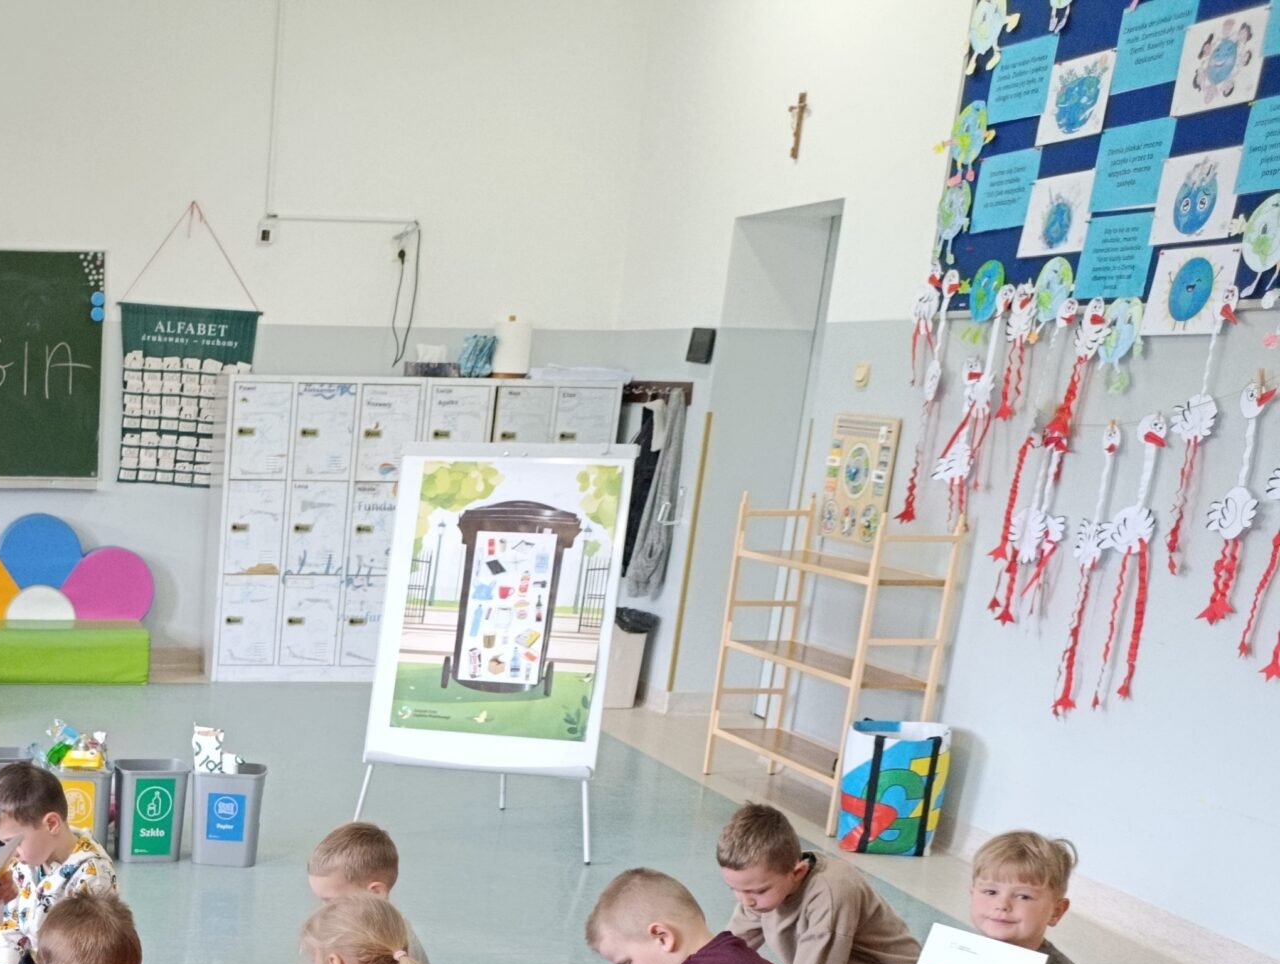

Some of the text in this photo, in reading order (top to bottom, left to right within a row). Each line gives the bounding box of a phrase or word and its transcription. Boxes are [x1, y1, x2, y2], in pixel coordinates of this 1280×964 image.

[154, 320, 228, 337] ALFABET
[141, 335, 189, 345] drukowany
[201, 340, 239, 349] ruchomy
[139, 828, 165, 837] Szkło
